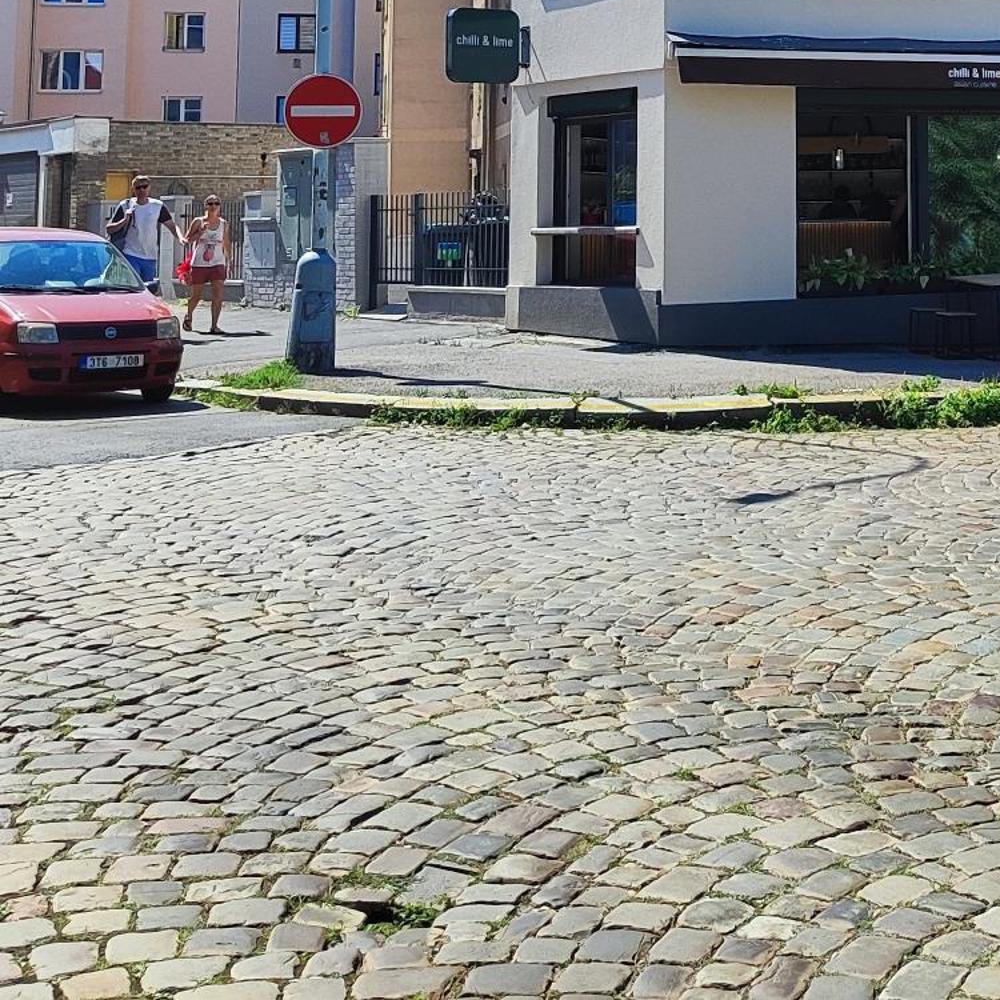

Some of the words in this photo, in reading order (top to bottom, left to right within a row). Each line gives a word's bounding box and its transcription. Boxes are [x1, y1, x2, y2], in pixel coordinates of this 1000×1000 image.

[456, 34, 480, 46] chilli
[482, 35, 490, 46] &
[492, 36, 513, 48] lime
[948, 67, 970, 78] chilli
[972, 67, 979, 78] &
